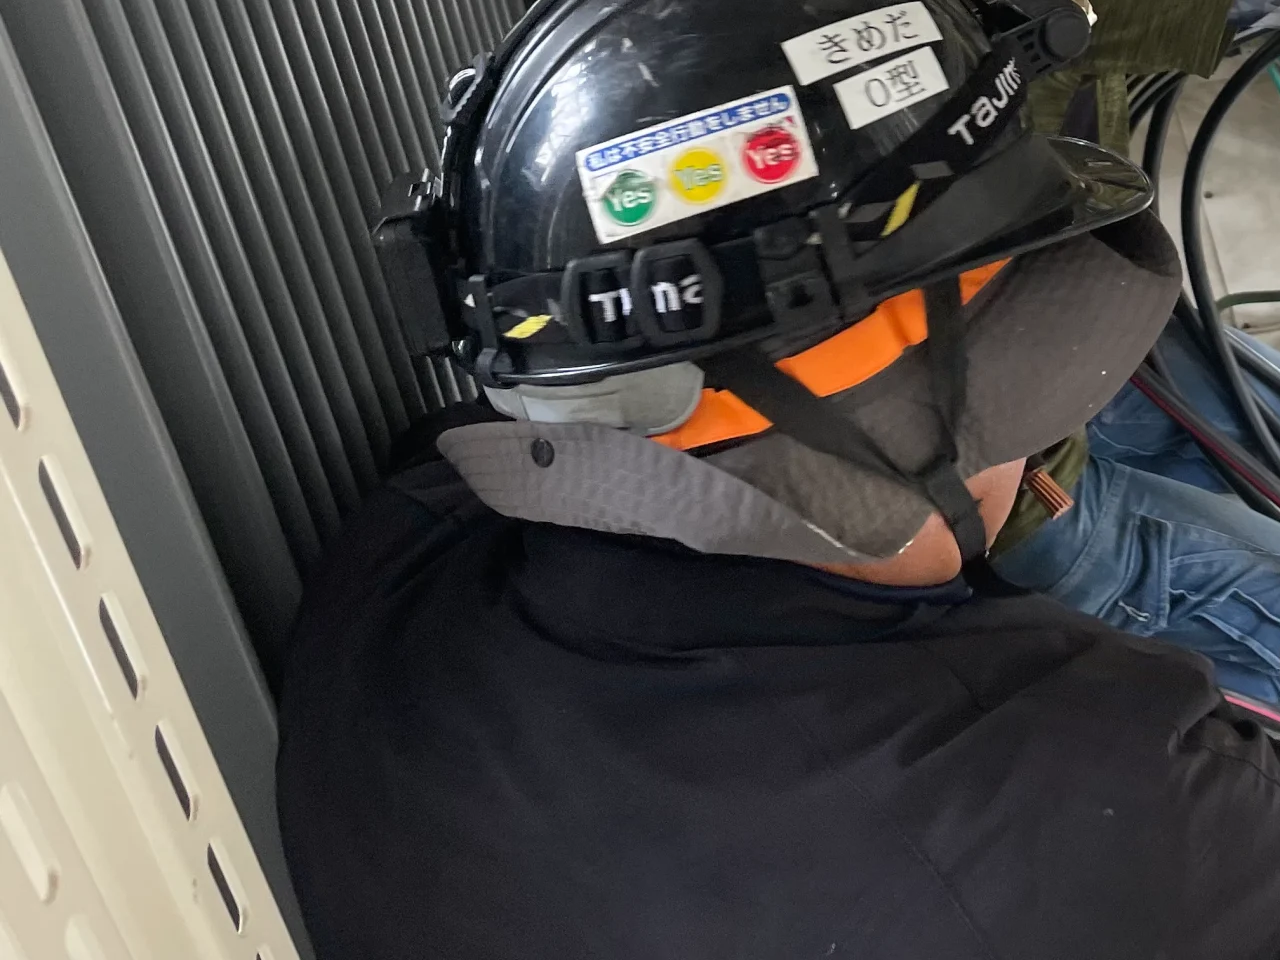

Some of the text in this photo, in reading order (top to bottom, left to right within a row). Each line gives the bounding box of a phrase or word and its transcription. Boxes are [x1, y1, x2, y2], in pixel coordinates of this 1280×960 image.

[816, 10, 919, 65] きめだ
[745, 143, 797, 169] Yes
[673, 164, 724, 191] Yes
[606, 187, 652, 212] Yes
